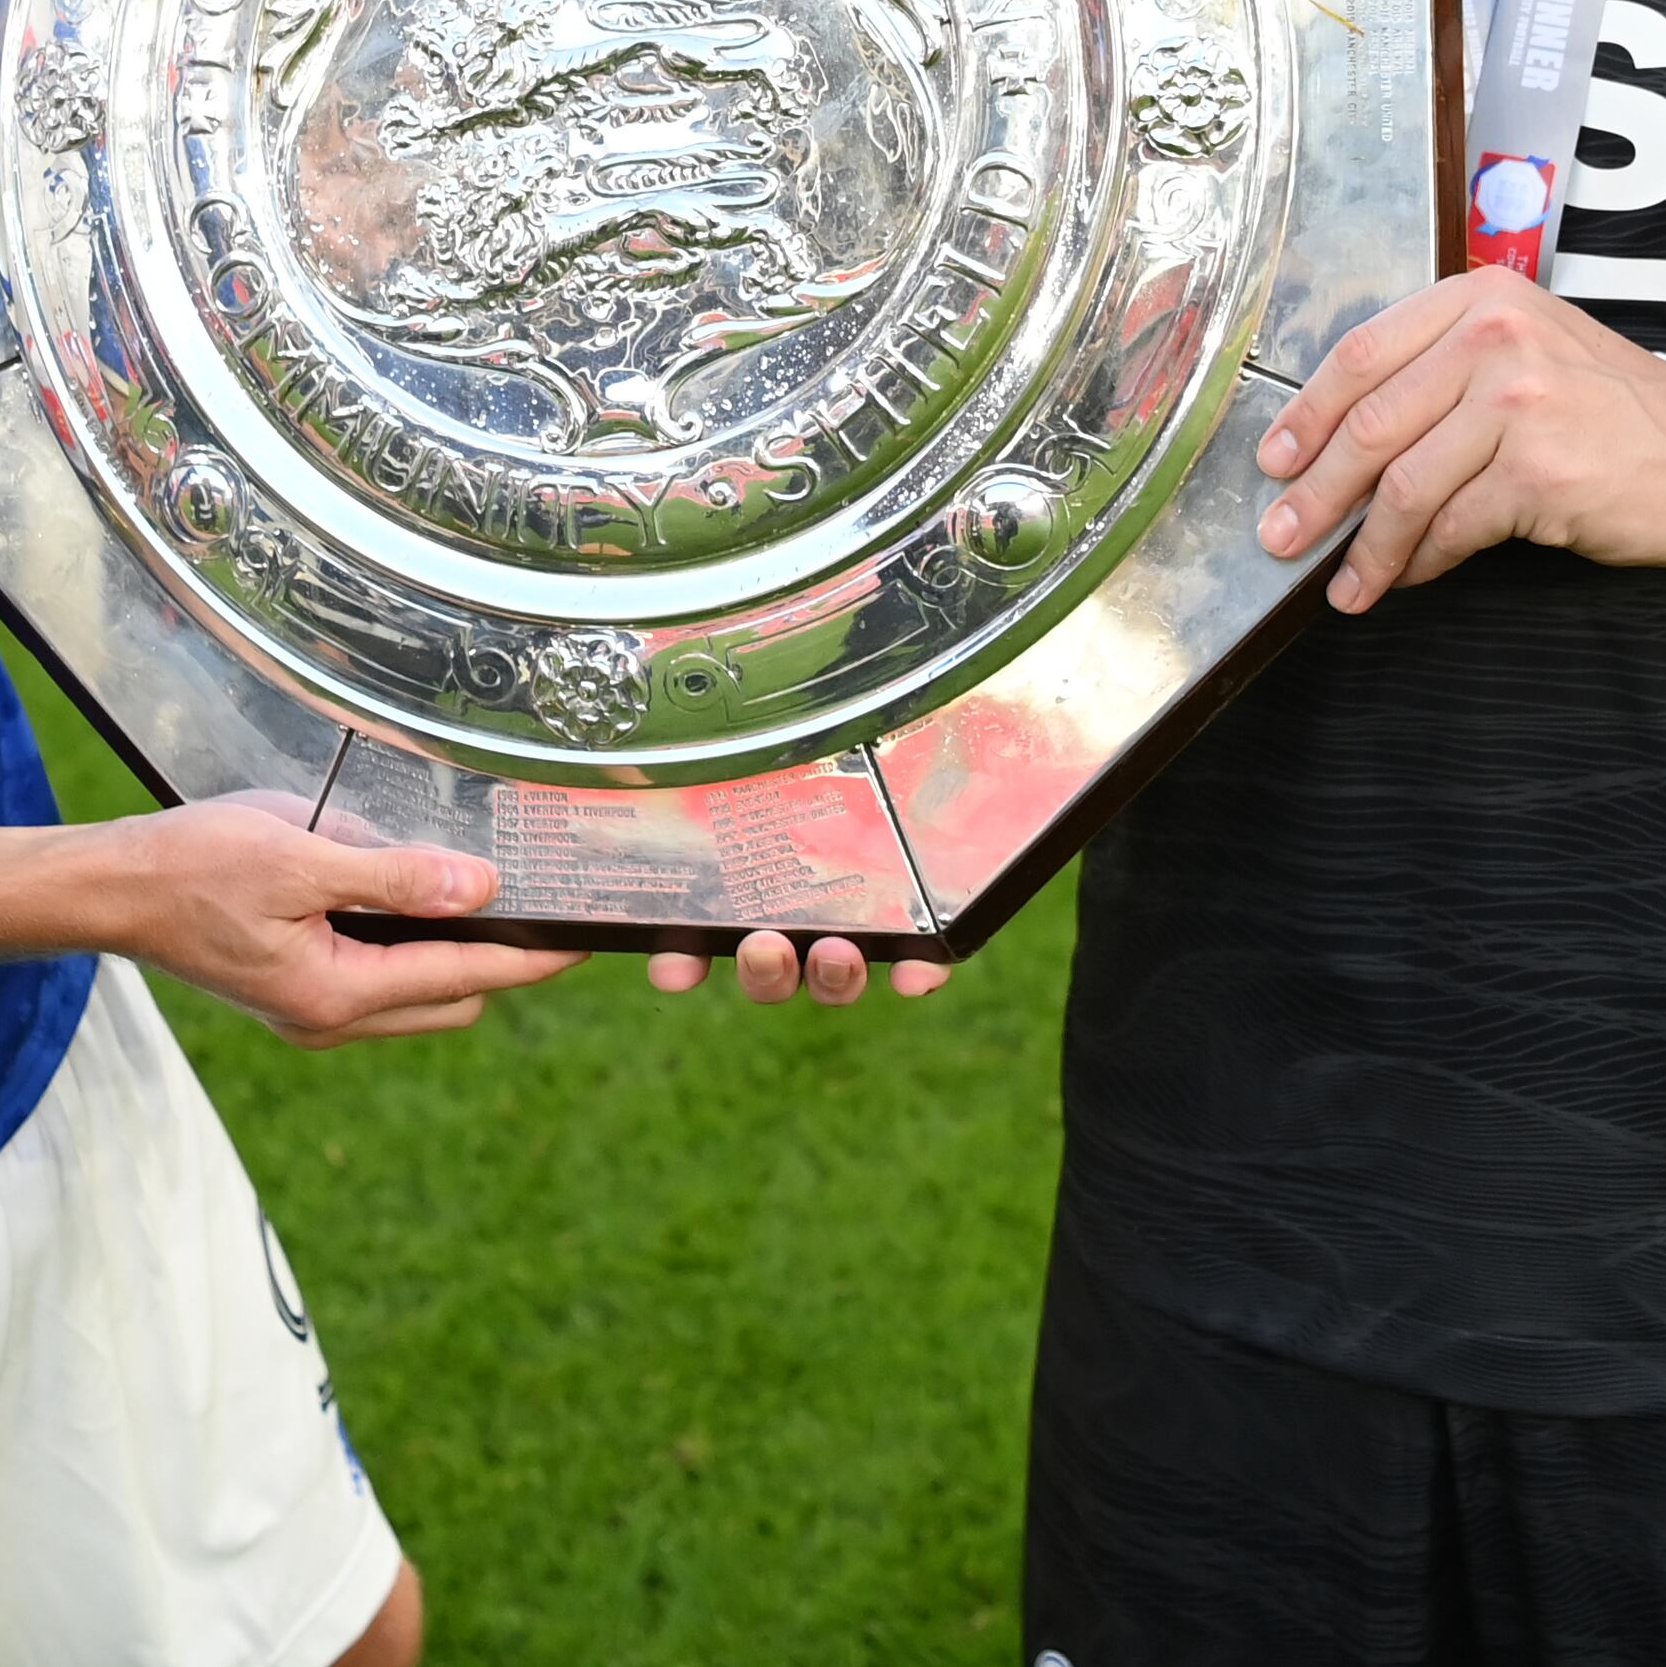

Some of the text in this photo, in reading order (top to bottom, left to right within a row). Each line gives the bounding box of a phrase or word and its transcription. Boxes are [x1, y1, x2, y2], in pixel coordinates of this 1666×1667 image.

[189, 147, 1038, 549] COMMUNITY SHIELD
[523, 790, 569, 803] EVERTON
[523, 804, 569, 817] EVERTON
[582, 806, 637, 819] LIVERPOOL
